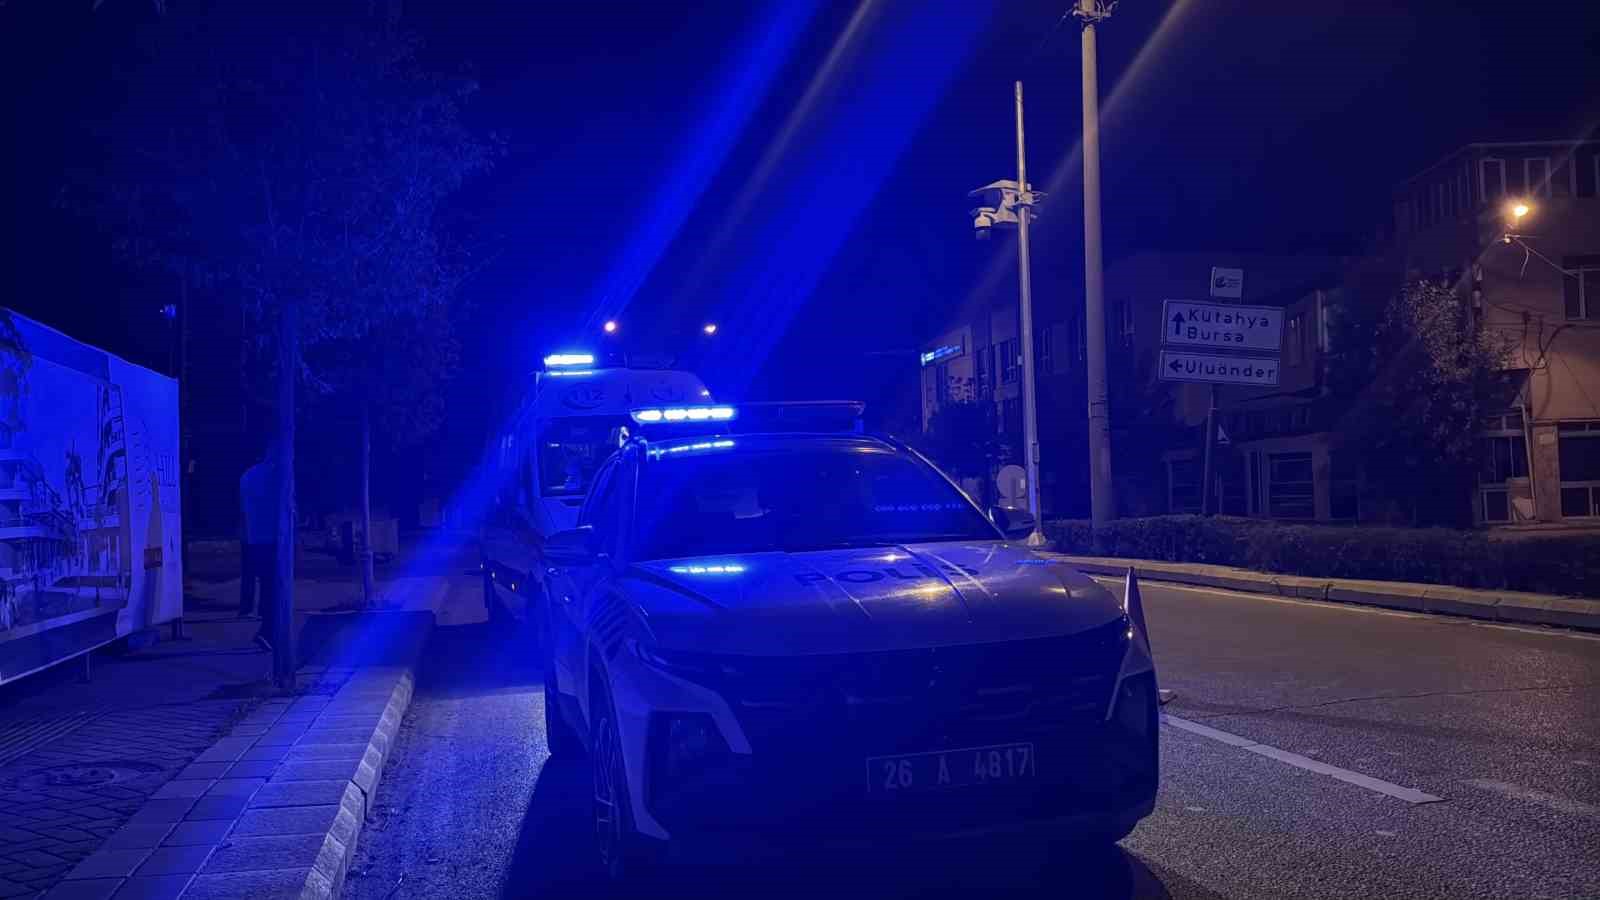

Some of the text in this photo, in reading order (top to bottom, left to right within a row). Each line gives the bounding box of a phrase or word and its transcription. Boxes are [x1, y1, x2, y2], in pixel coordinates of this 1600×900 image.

[1187, 326, 1244, 343] Bursa
[884, 747, 1029, 791] 26 A 4817
